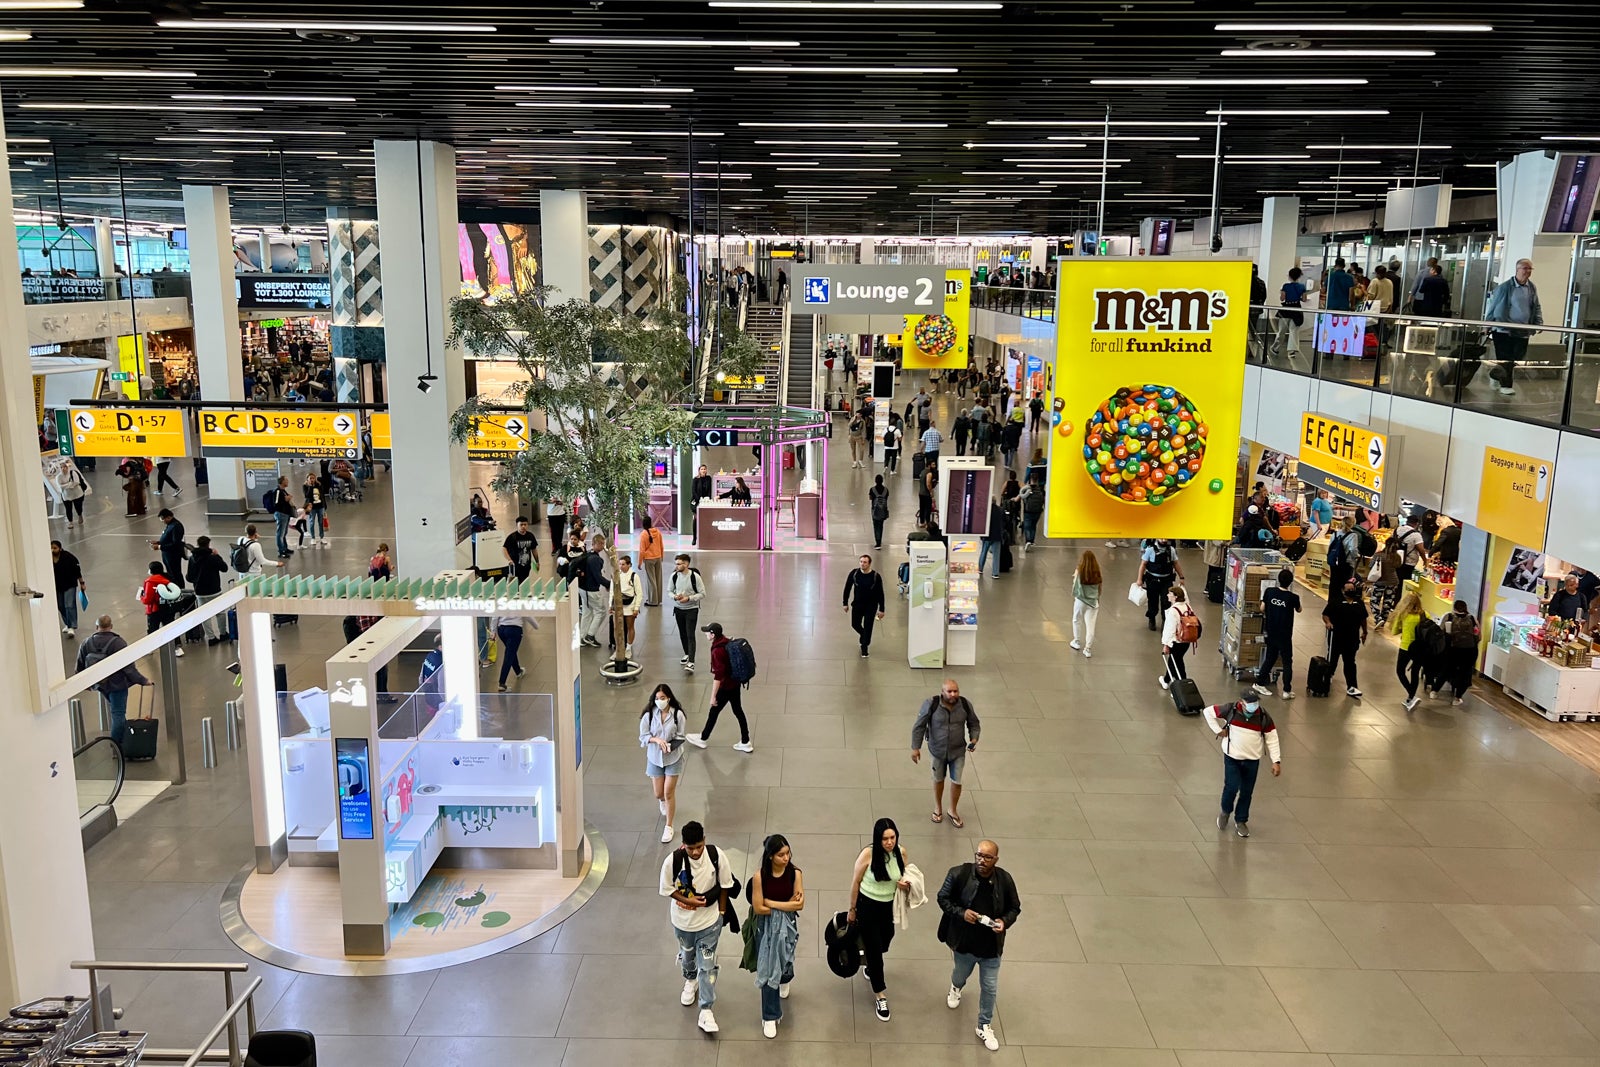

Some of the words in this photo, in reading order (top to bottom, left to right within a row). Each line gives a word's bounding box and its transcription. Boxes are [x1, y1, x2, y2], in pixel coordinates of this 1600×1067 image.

[836, 282, 909, 303] Lounge
[914, 277, 934, 306] 2
[1090, 338, 1107, 352] for
[1108, 338, 1123, 352] all
[1126, 338, 1212, 352] funkind
[116, 412, 133, 431] D
[138, 416, 166, 427] 1-57
[204, 414, 217, 432] B
[225, 414, 239, 433] C
[252, 415, 268, 433] D
[274, 418, 312, 428] 59-87
[1490, 455, 1514, 469] Baggage
[1516, 461, 1526, 471] hall
[1352, 468, 1366, 483] T5-9
[1324, 477, 1337, 488] Airline
[1337, 482, 1352, 494] lounges
[1513, 482, 1523, 492] Exit
[415, 596, 496, 613] Sanitising
[497, 597, 556, 610] Service
[1271, 598, 1286, 607] GSA
